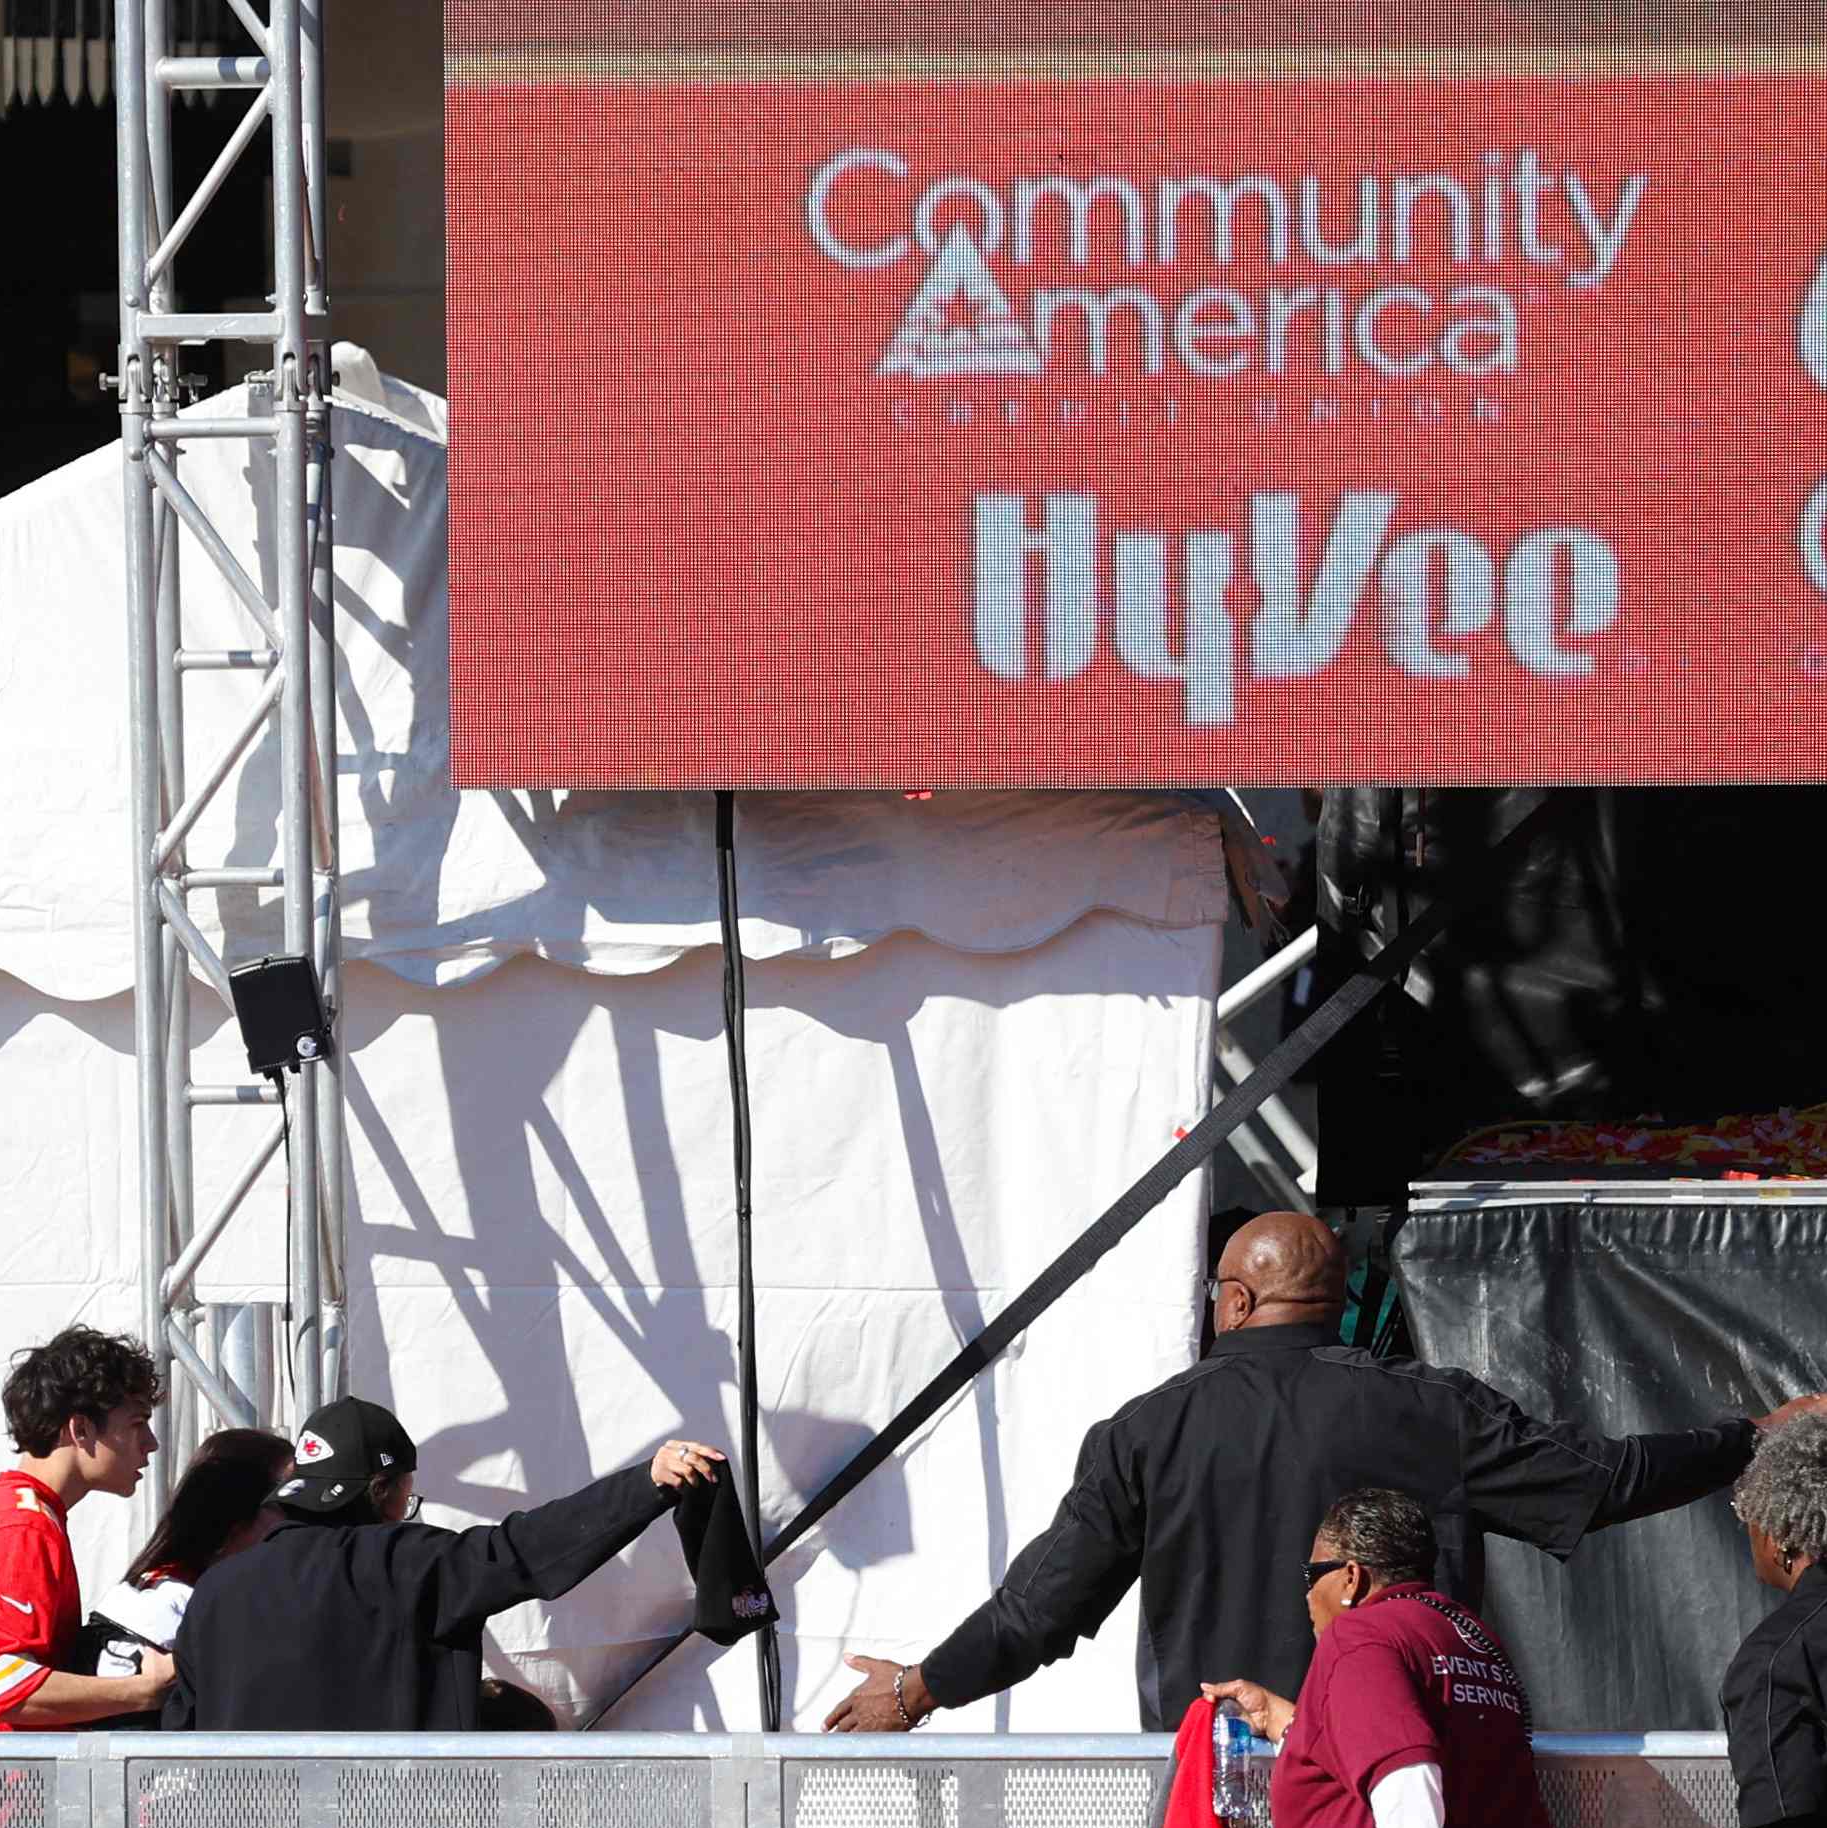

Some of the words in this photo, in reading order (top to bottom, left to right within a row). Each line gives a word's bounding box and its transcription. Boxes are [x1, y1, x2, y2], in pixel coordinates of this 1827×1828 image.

[806, 147, 1650, 287] Community
[876, 222, 1517, 379] America
[971, 489, 1622, 726] HyVee
[1431, 1655, 1487, 1680] EVENT
